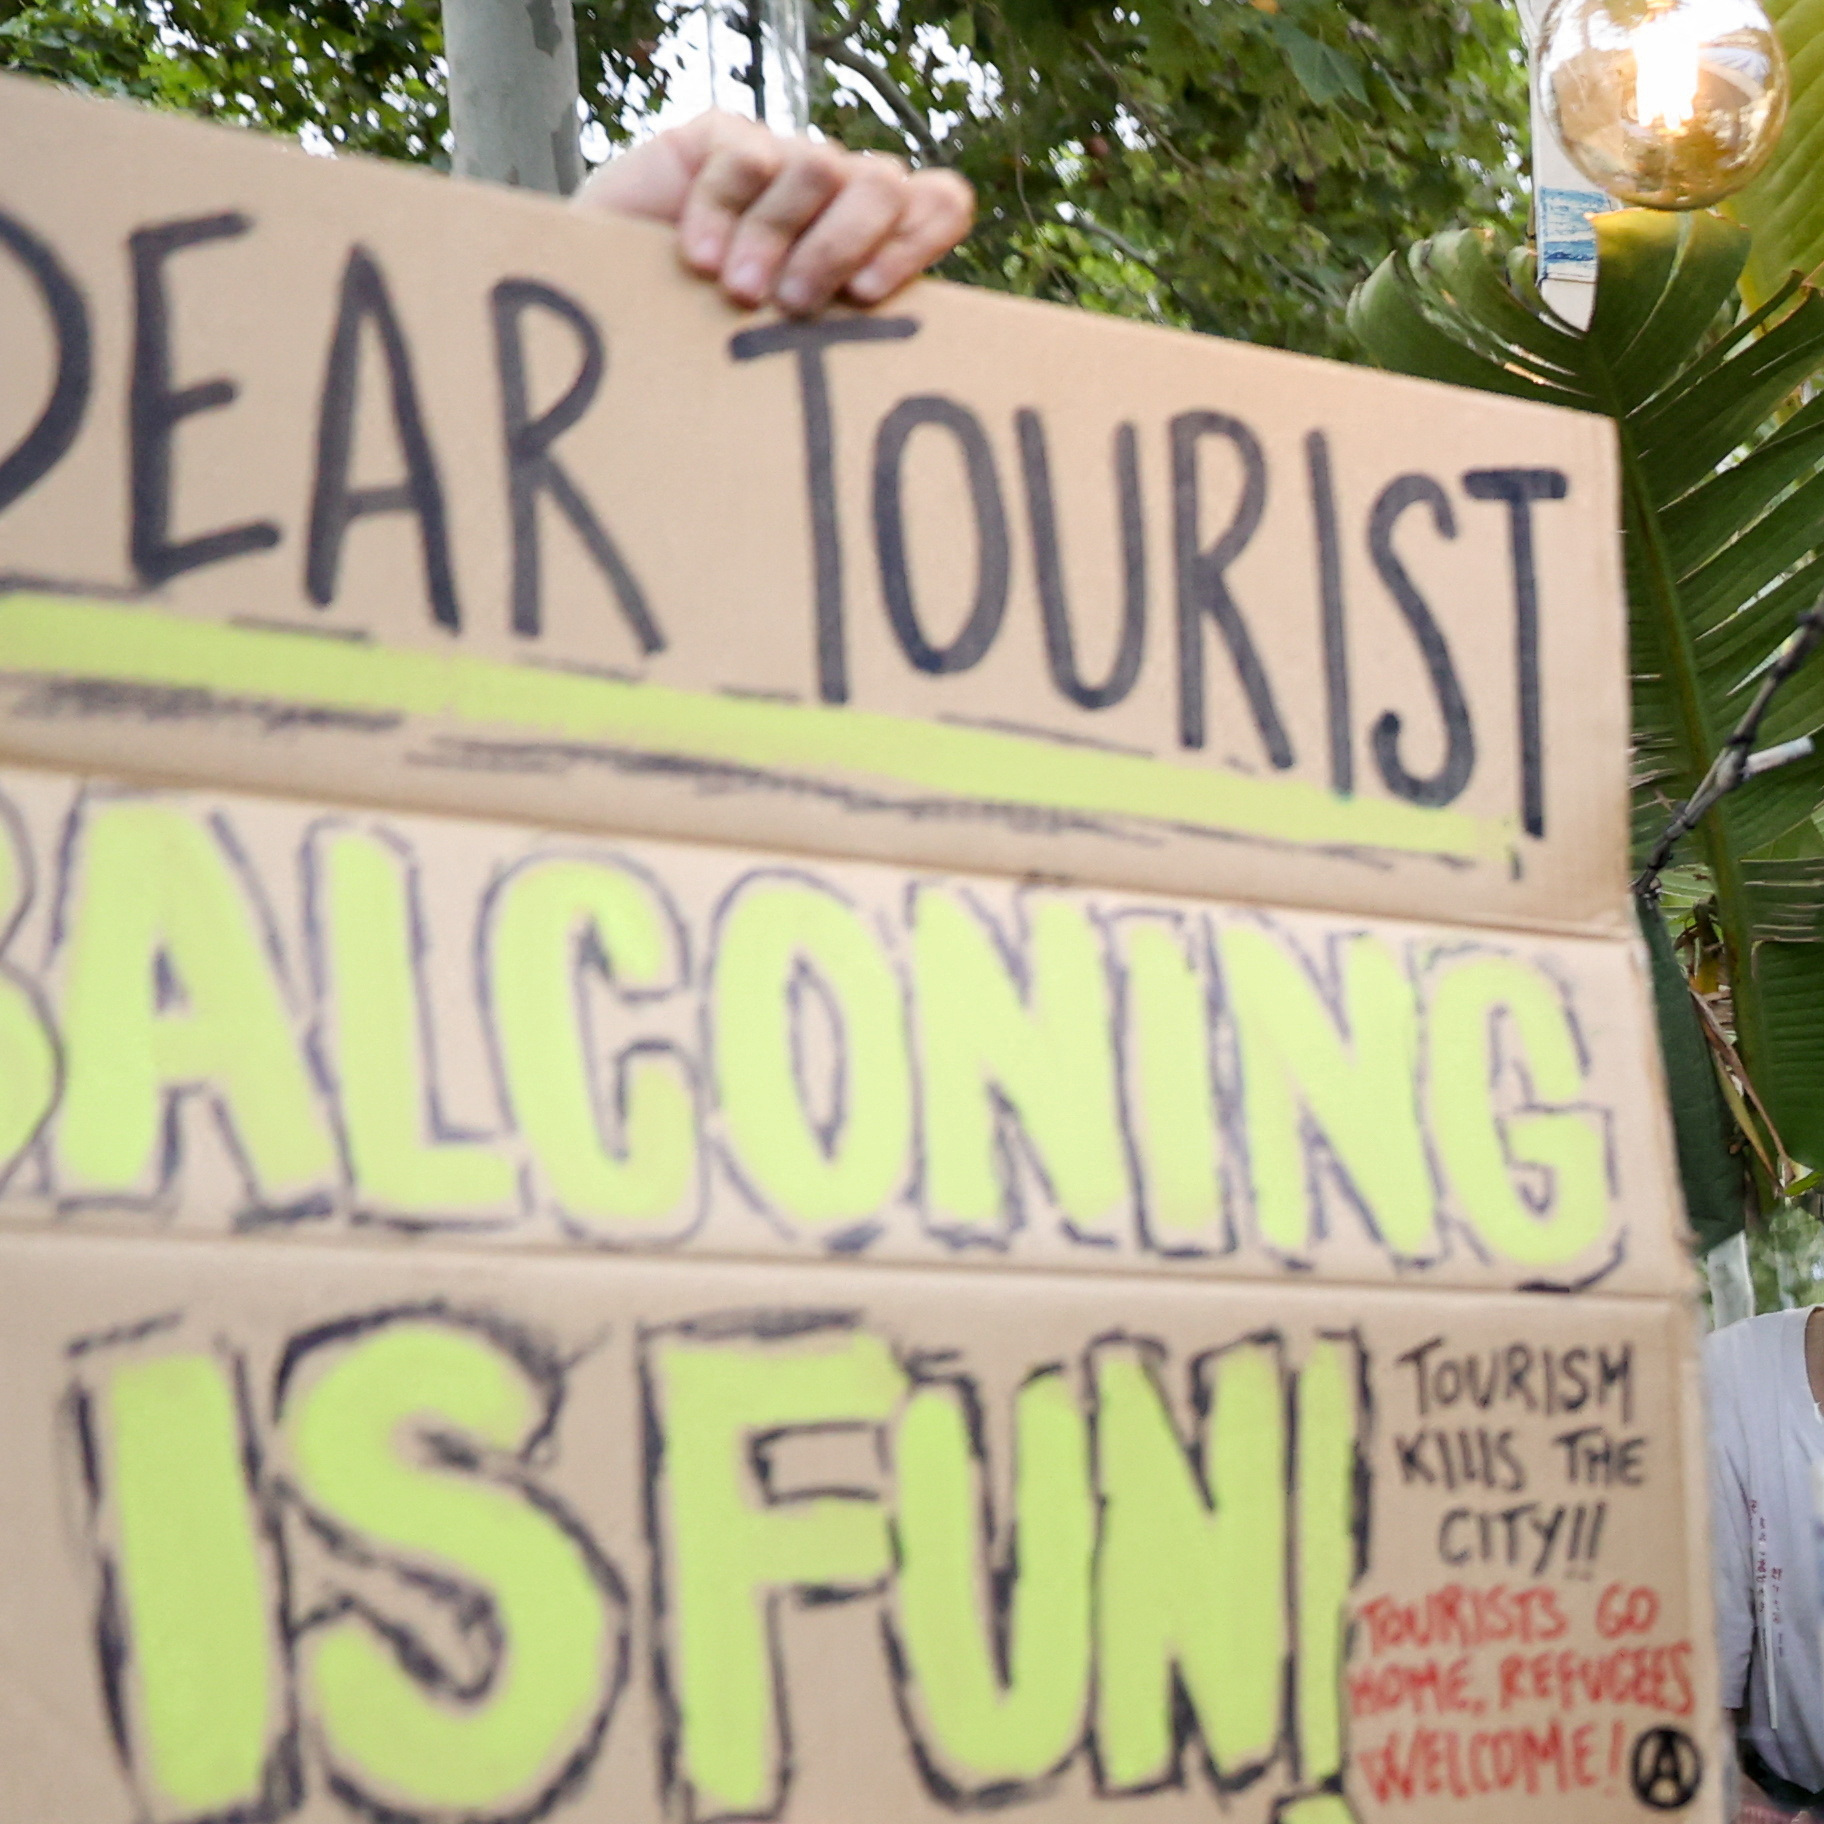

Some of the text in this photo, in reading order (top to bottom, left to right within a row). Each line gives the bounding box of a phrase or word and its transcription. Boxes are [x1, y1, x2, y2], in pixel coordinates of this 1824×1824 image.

[730, 316, 1567, 836] TOURIST
[1394, 1334, 1634, 1424] TOURISM
[1395, 1426, 1650, 1491] KILLS THE
[1437, 1500, 1607, 1581] CITY!!
[1352, 1582, 1661, 1656] TOURISTS GO
[1498, 1641, 1697, 1717] REFUGEES
[1354, 1718, 1626, 1804] WELCOME!
